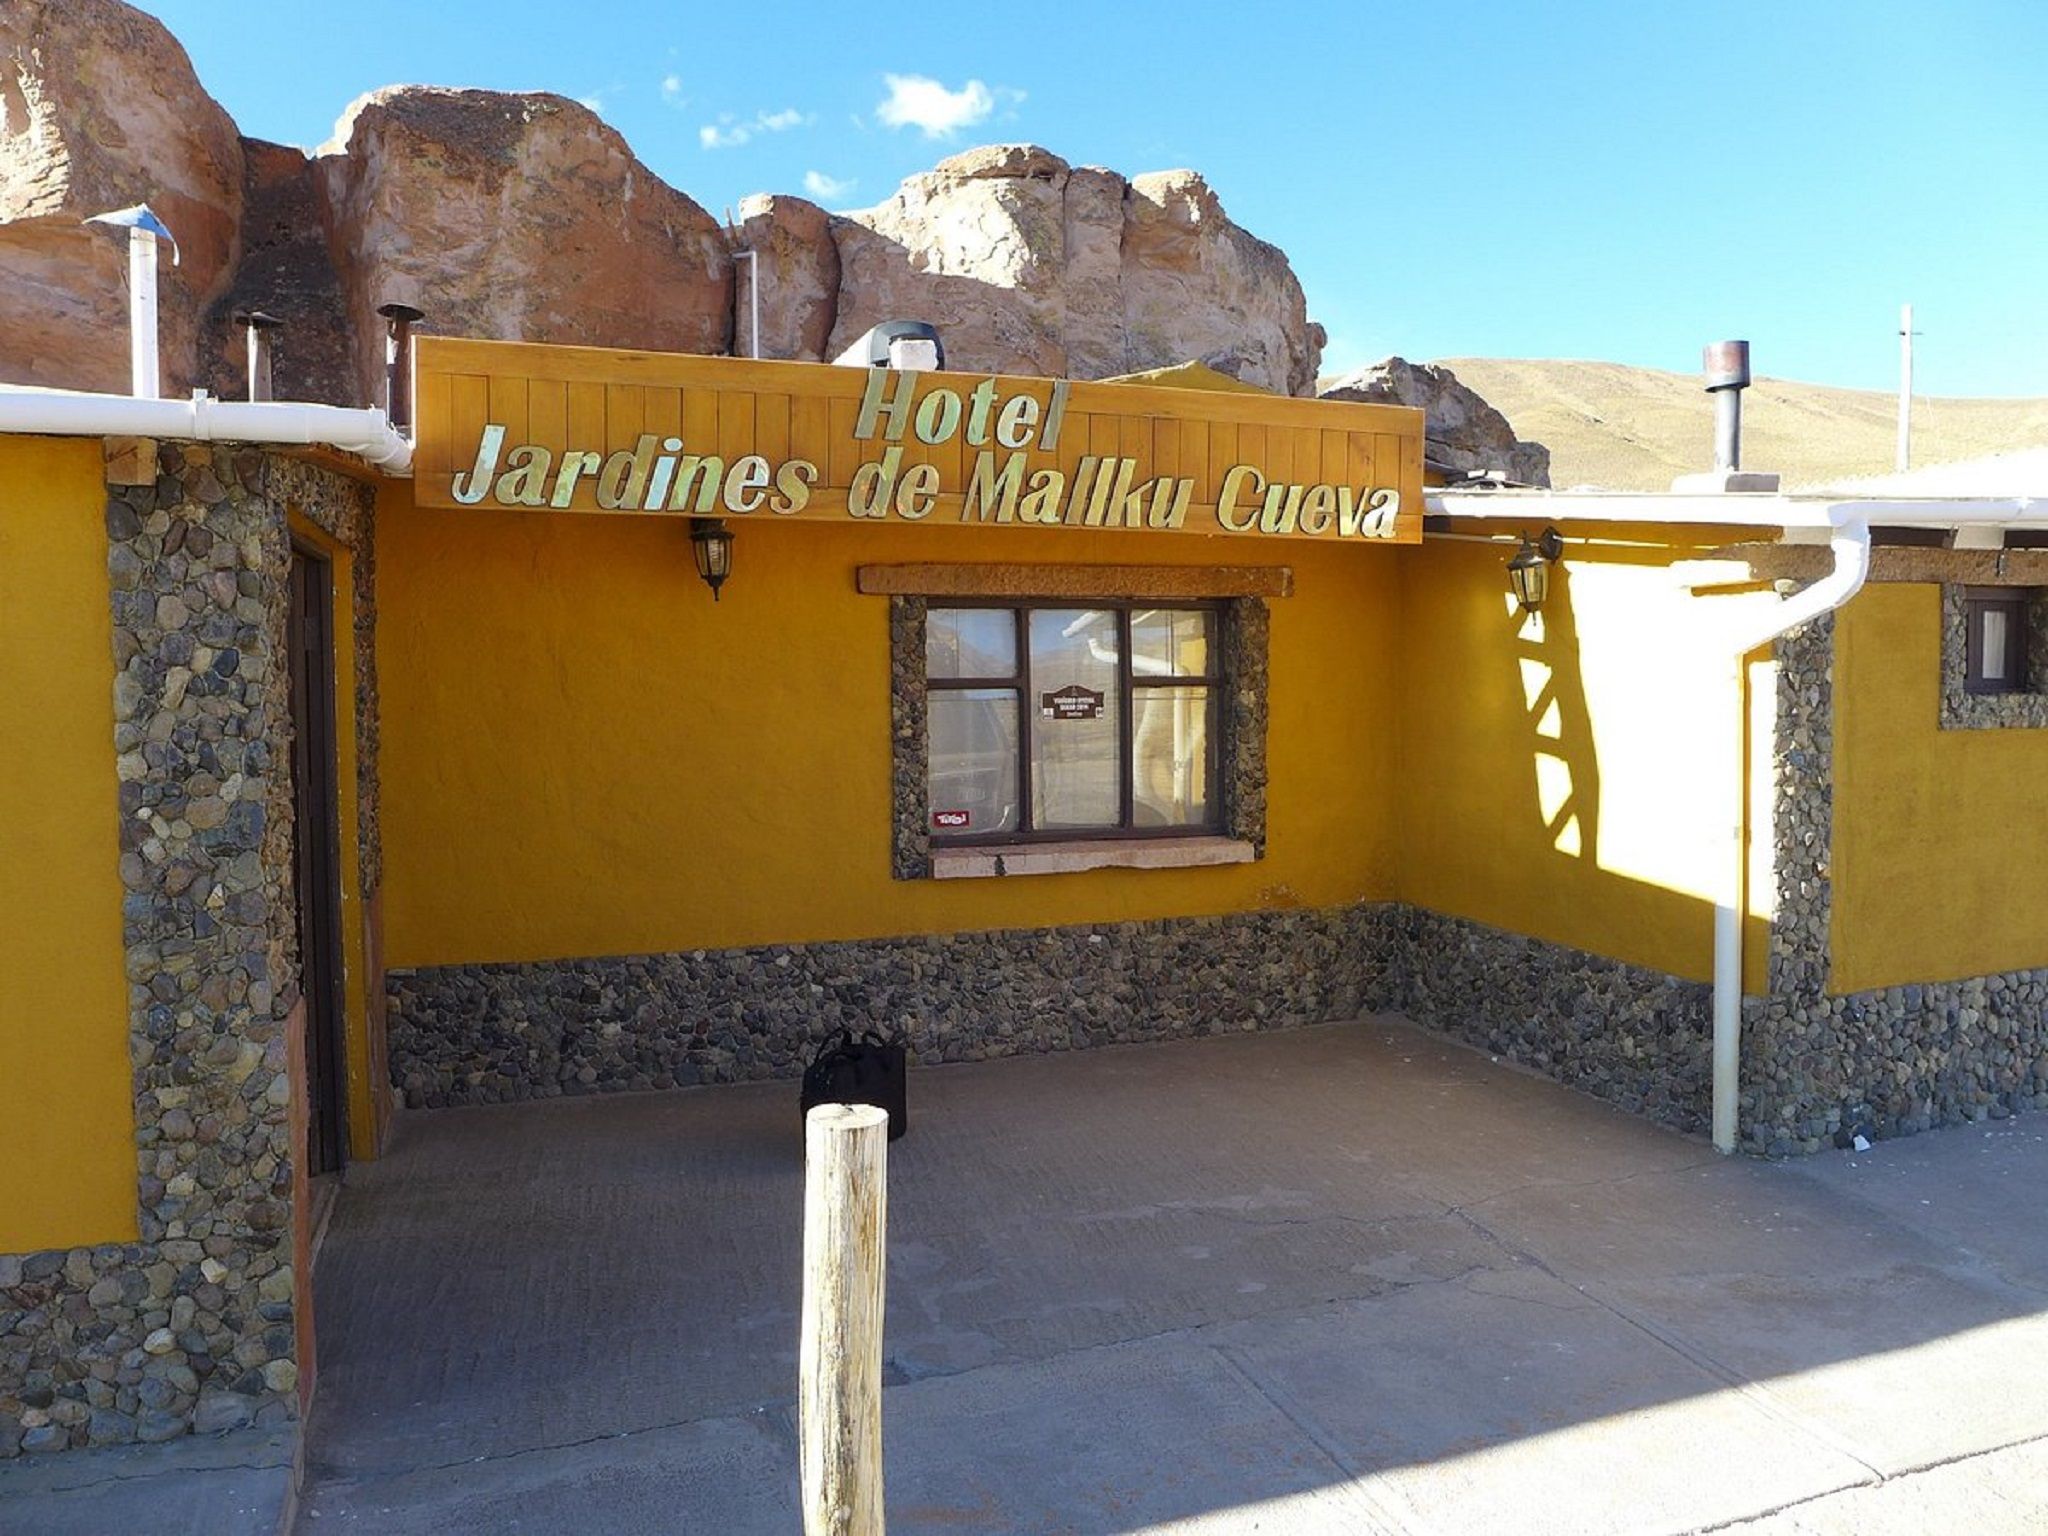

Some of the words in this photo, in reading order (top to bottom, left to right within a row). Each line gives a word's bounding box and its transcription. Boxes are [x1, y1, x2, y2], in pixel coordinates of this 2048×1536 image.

[853, 368, 1070, 451] Hotel
[451, 424, 818, 513] Jardines
[847, 447, 940, 520] de
[961, 450, 1195, 529] Mallku
[1216, 464, 1401, 539] Cueva
